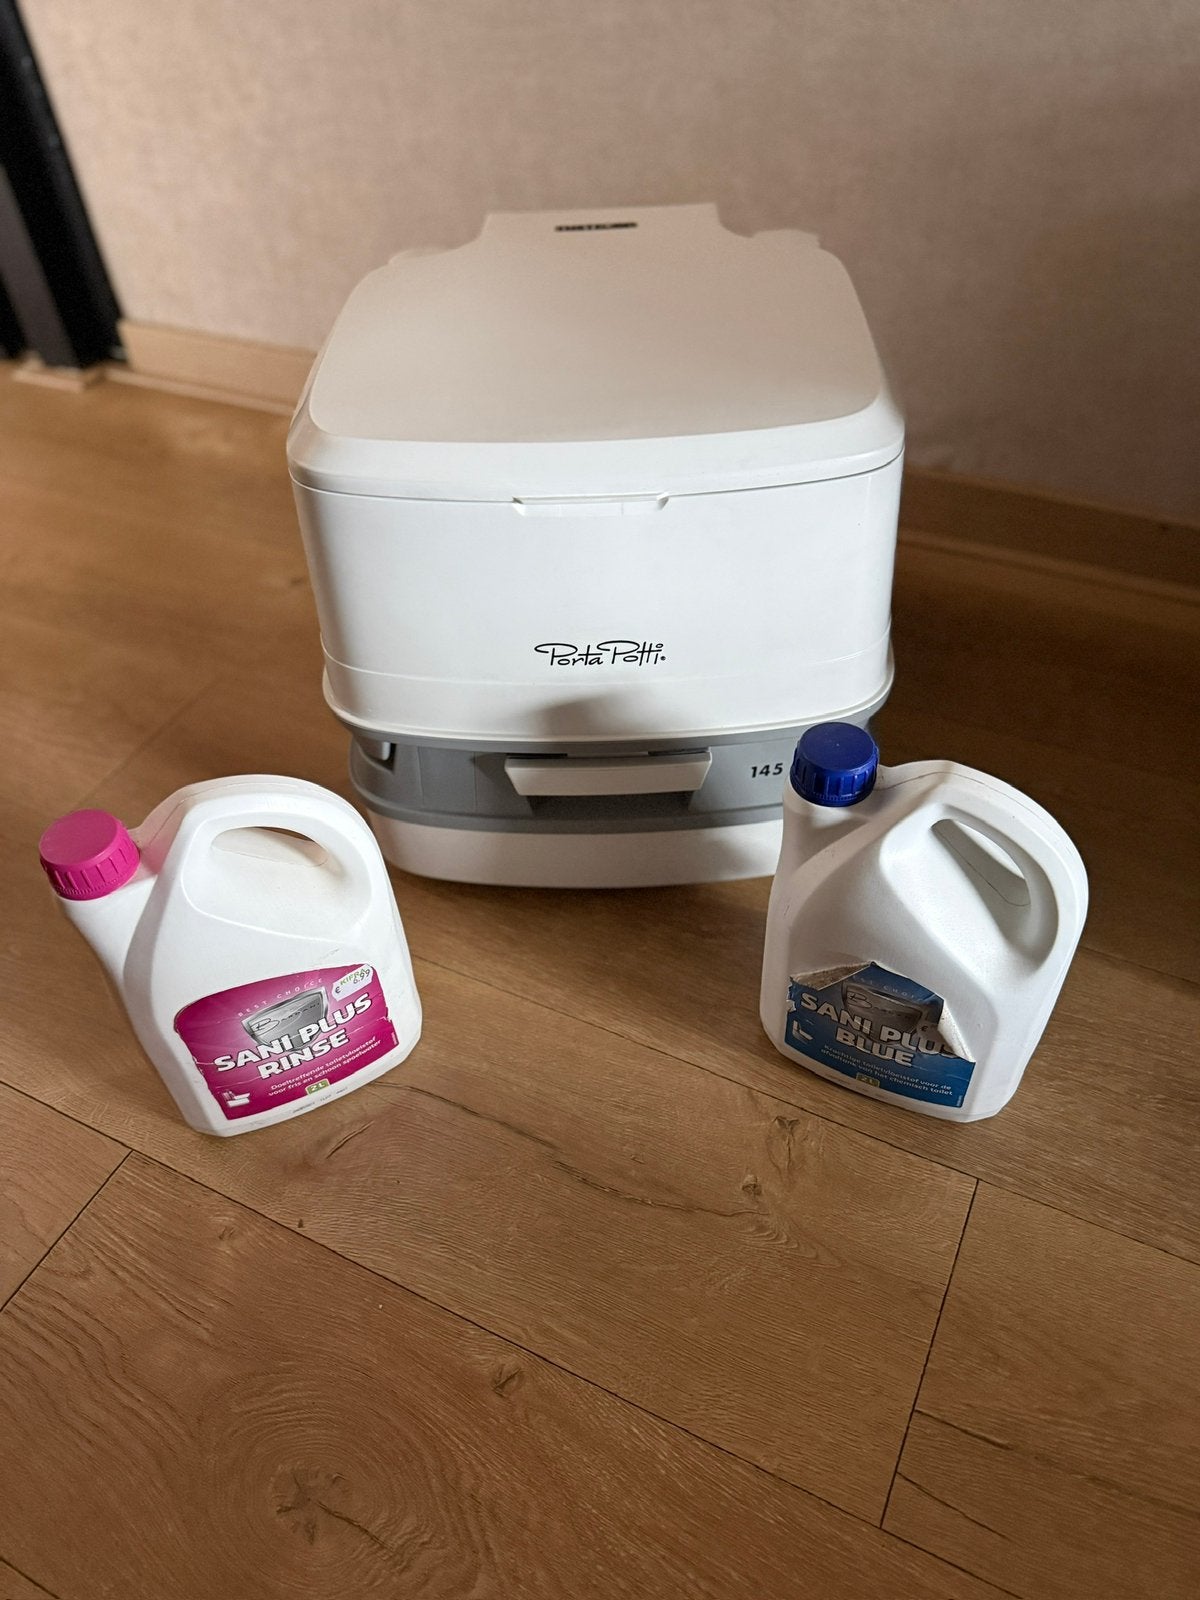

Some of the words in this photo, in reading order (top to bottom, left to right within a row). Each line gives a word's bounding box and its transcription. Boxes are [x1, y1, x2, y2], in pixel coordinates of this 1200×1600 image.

[534, 642, 604, 666] Porta
[750, 762, 784, 778] 145
[213, 1034, 295, 1072] SANI
[298, 992, 373, 1046] PLUS
[800, 992, 872, 1034] SANI
[257, 1028, 349, 1080] RINSE
[270, 1065, 325, 1090] Doeltreffende
[325, 1036, 376, 1068] toiletvloeistof
[835, 1027, 915, 1067] BLUE
[268, 1086, 287, 1097] voor
[303, 1076, 314, 1085] en
[314, 1063, 342, 1079] schoon
[342, 1039, 382, 1066] spoelwater
[920, 1080, 940, 1089] voor
[930, 1087, 954, 1096] toilet
